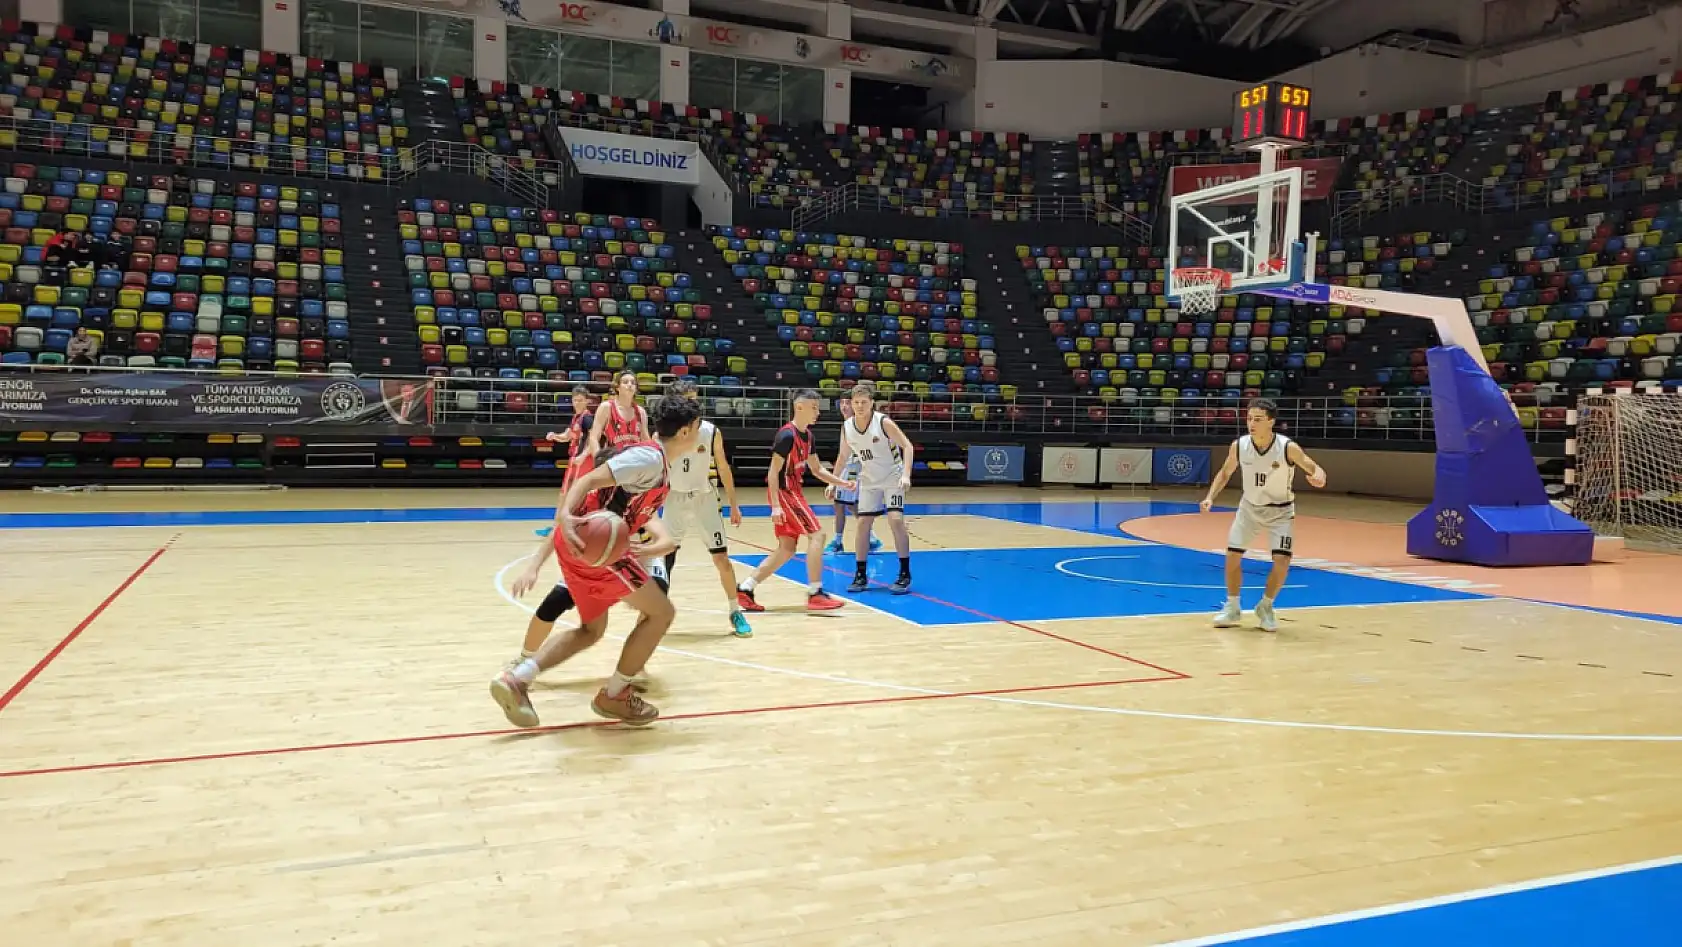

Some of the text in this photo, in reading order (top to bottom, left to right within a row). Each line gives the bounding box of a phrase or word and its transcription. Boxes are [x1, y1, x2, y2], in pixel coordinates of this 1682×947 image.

[571, 143, 688, 169] HOŞGELDİNİZ
[95, 388, 124, 396] Osman
[204, 384, 290, 396] TÜM ANTRENÖR
[67, 397, 106, 407] GENÇLİK
[121, 398, 145, 406] SPOR
[191, 395, 302, 405] VE SPORCULARIMIZA
[195, 405, 298, 415] BAŞARILAR DİLİYORUM
[860, 448, 873, 461] 30
[683, 457, 690, 472] 3
[1254, 472, 1266, 487] 19
[890, 494, 903, 507] 30
[713, 531, 723, 546] 3
[1280, 535, 1292, 549] 19
